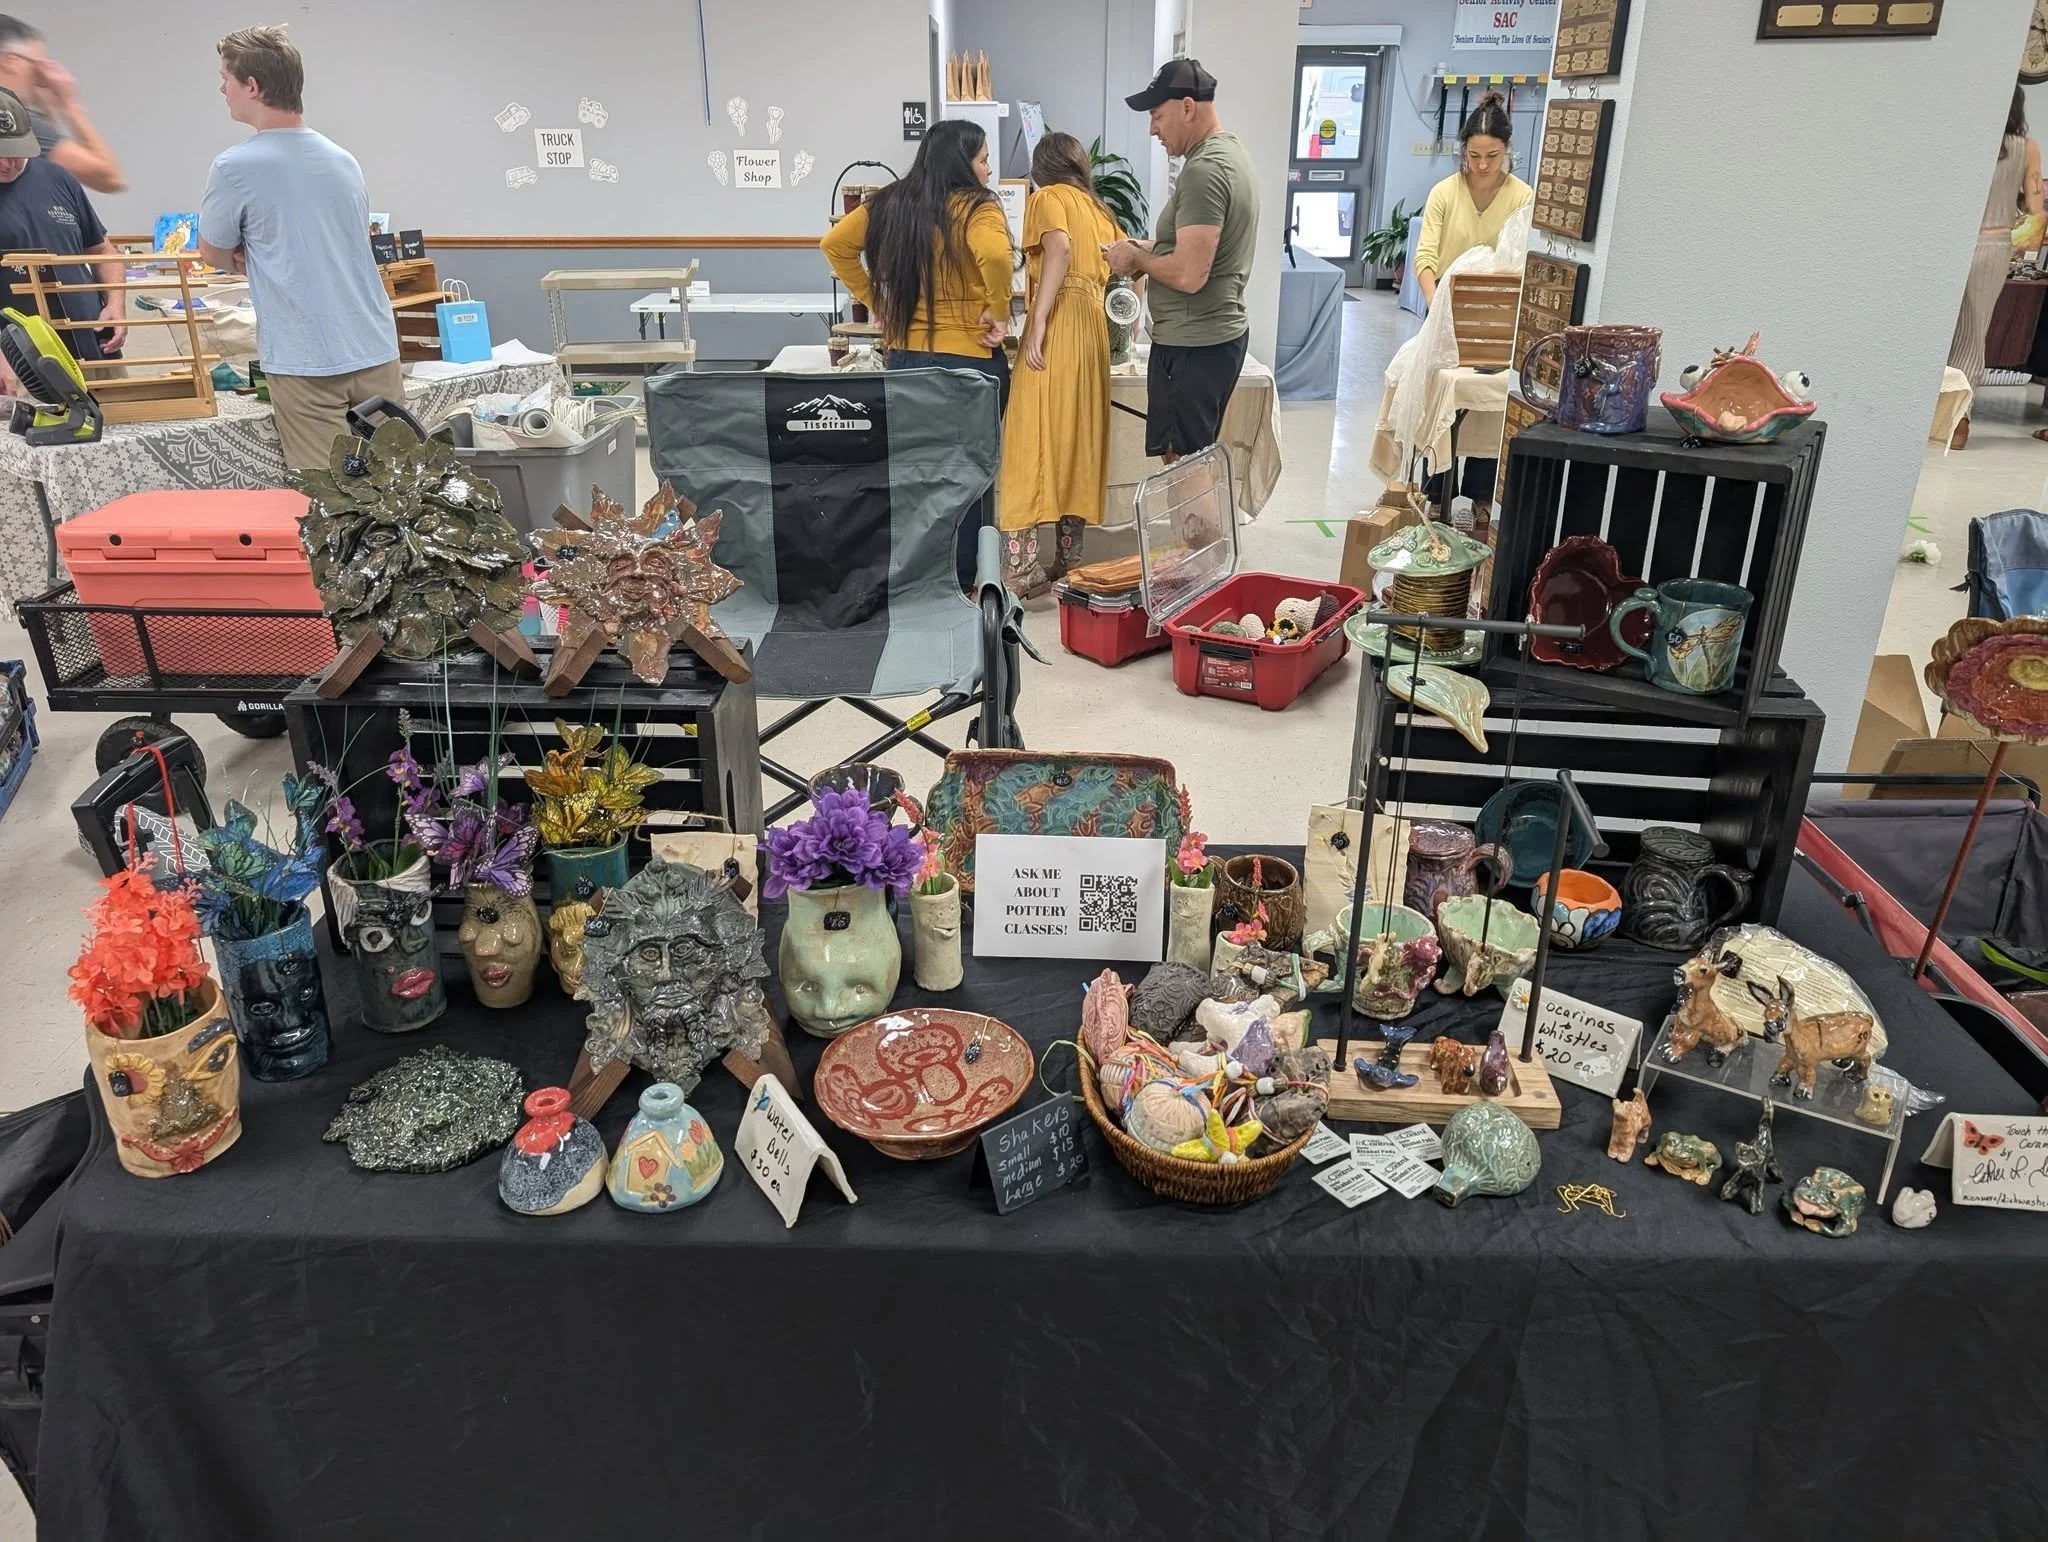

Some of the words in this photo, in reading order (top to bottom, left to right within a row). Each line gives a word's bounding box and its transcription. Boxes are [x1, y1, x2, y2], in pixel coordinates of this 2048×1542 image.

[1493, 12, 1518, 28] SAC
[1501, 35, 1511, 44] The
[1511, 35, 1524, 44] Lives
[1525, 35, 1533, 44] Of
[540, 133, 574, 146] TRUCK
[546, 152, 572, 165] STOP
[736, 155, 776, 166] Flower
[744, 171, 771, 186] Shop
[1667, 633, 1682, 644] 50
[1012, 868, 1039, 879] ASK
[1042, 869, 1062, 879] ME
[1014, 887, 1061, 898] ABOUT
[1006, 905, 1068, 917] POTTERY
[1004, 923, 1068, 935] CLASSES!
[767, 1104, 795, 1143] Water
[767, 1137, 790, 1176] Bells
[2000, 1148, 2014, 1161] by
[1002, 1156, 1042, 1188] medium
